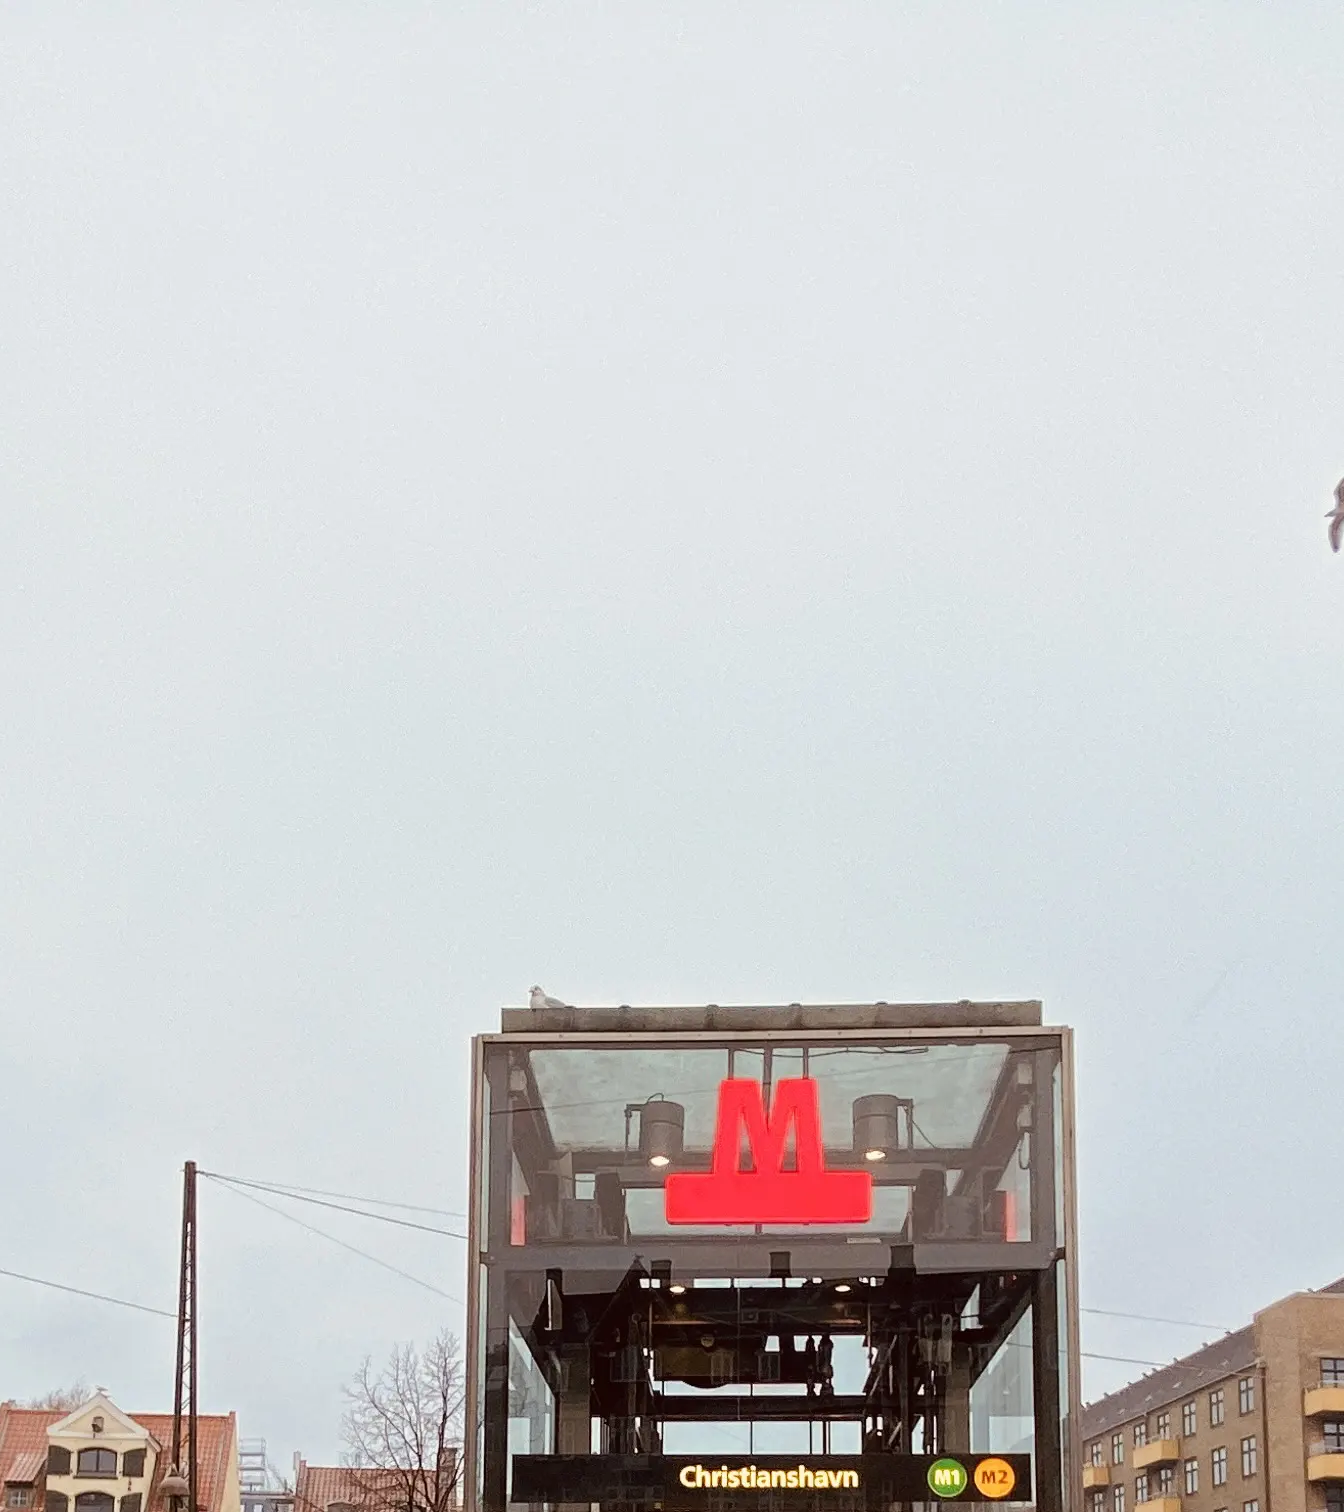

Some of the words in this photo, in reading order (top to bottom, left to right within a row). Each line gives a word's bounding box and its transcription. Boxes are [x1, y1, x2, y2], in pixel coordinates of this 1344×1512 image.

[679, 1464, 860, 1489] Christianshavn
[933, 1467, 961, 1486] M1
[981, 1469, 1010, 1485] M2
